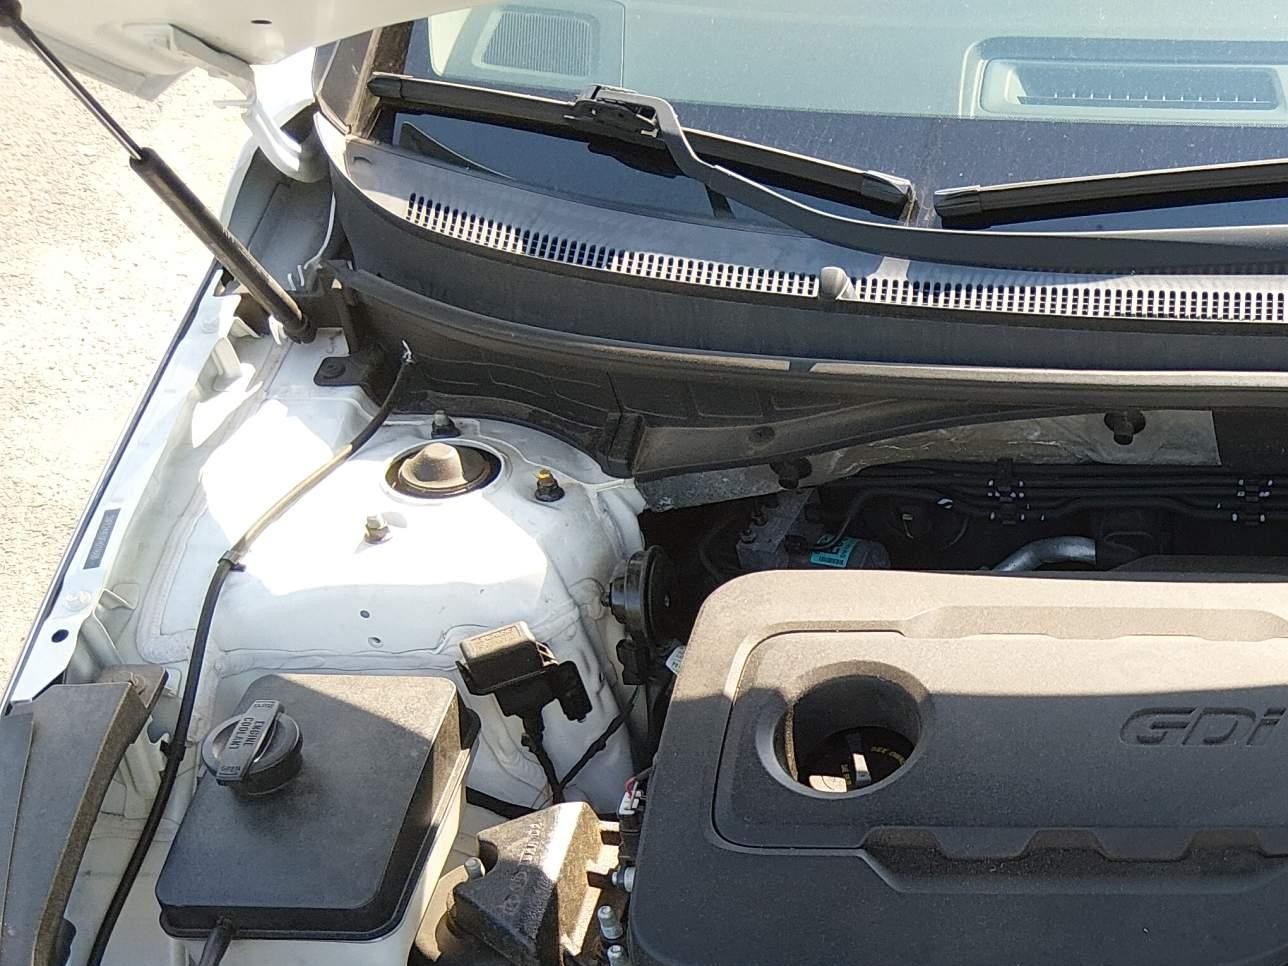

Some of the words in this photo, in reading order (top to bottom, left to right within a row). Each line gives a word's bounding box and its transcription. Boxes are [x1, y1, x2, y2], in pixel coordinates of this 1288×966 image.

[229, 717, 254, 750] COOLANT
[243, 721, 265, 746] ENGINE
[1119, 706, 1287, 747] GDi
